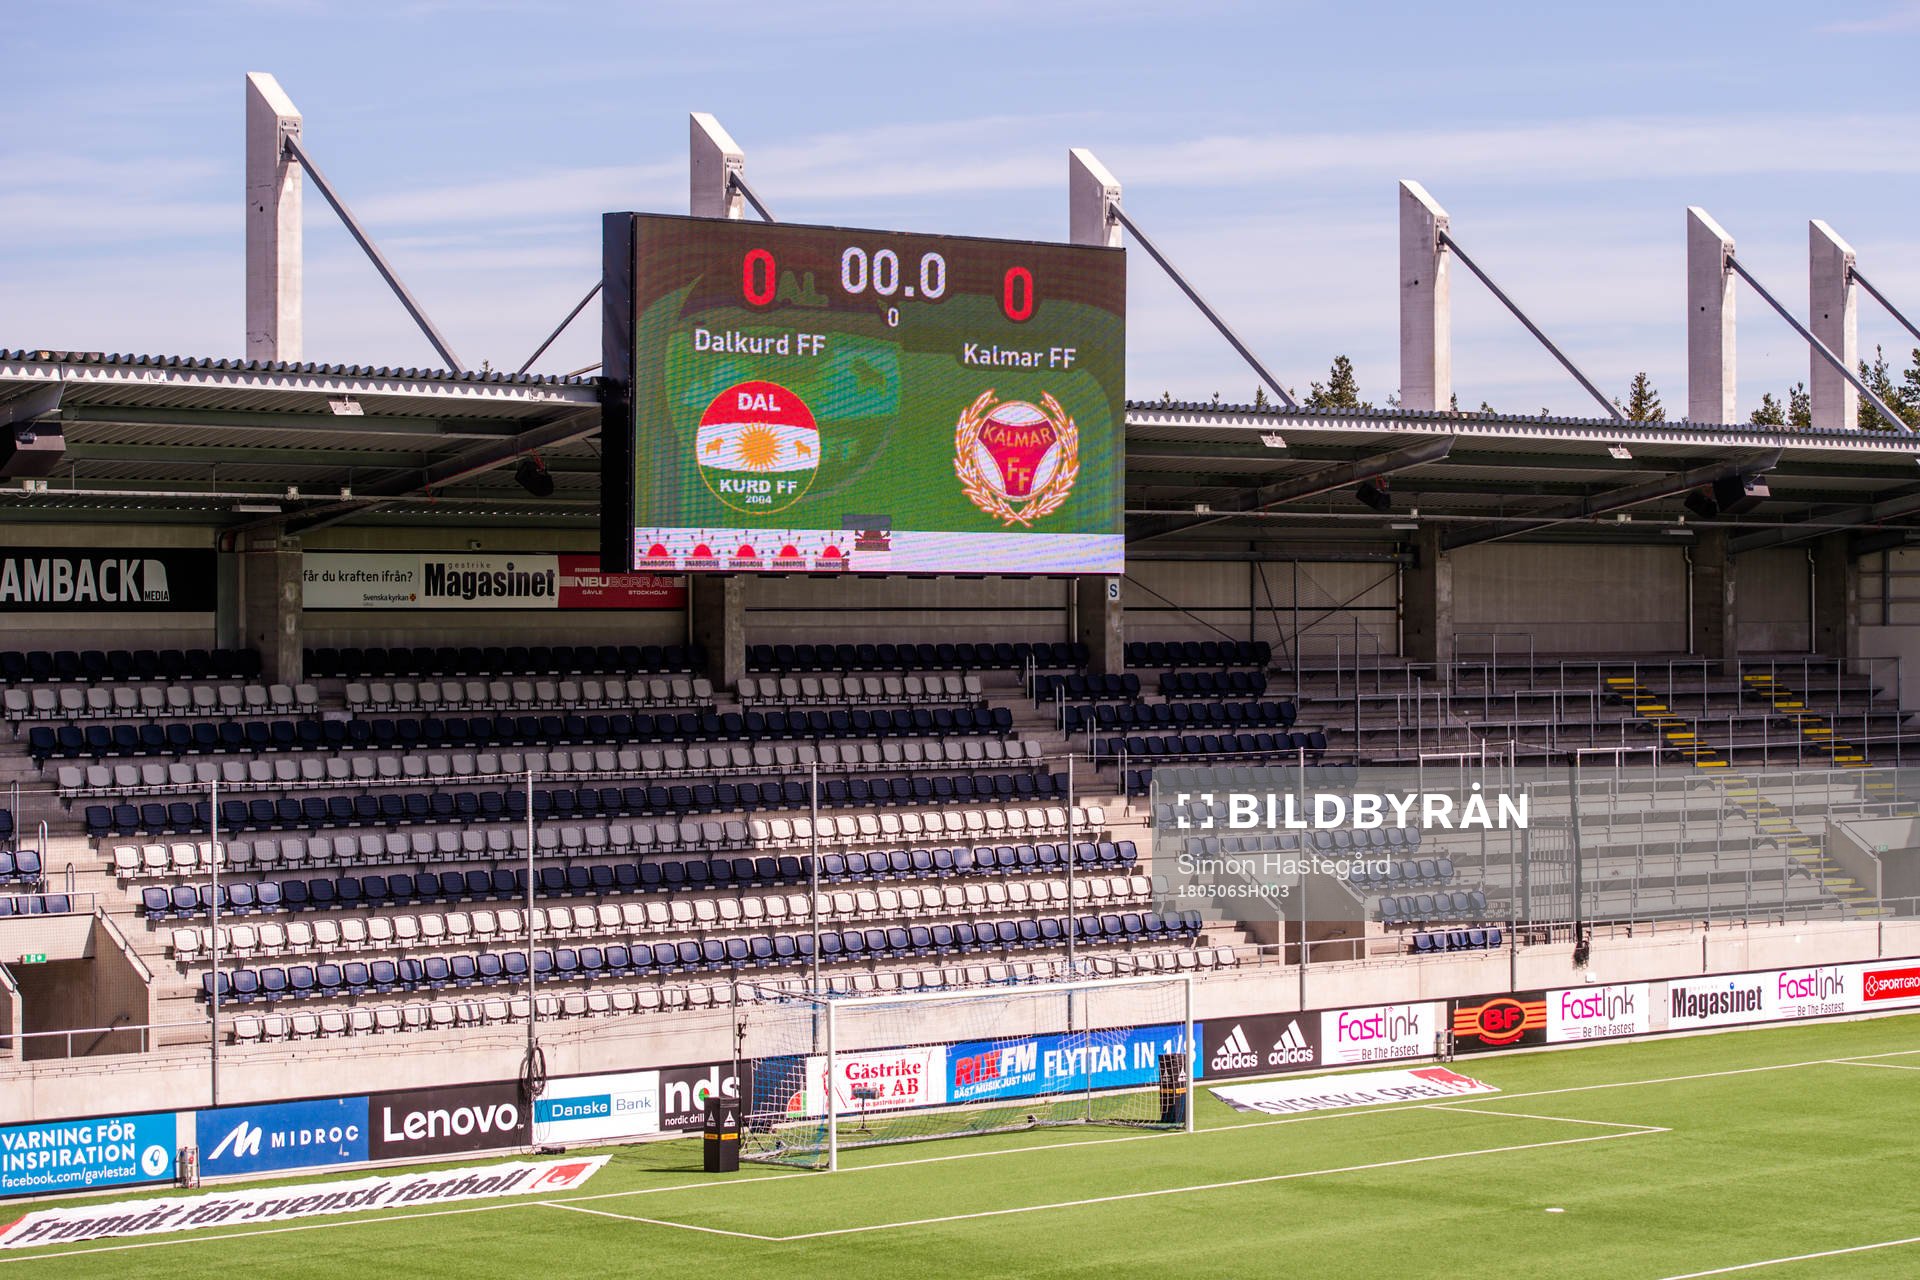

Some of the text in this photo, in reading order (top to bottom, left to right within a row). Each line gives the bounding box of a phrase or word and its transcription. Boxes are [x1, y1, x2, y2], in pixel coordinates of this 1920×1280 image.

[743, 249, 776, 305] 0
[841, 246, 946, 299] 00.0
[1004, 266, 1033, 321] 0
[887, 307, 899, 327] 0
[695, 328, 826, 356] Dalkurd FF
[963, 343, 1076, 368] Kalmar FF
[738, 392, 781, 412] DAL
[983, 423, 1052, 449] KALMAR
[720, 479, 798, 494] KURD FF
[0, 558, 142, 602] AMBACK
[303, 570, 413, 582] får du kraften ifrån?
[424, 562, 556, 601] Magasinet
[144, 590, 170, 601] MEDIA
[362, 593, 409, 604] Svenska kyrkan
[1109, 583, 1118, 598] S
[1672, 982, 1763, 1020] Magasinet
[1797, 1001, 1845, 1016] Be The Fastest
[1483, 1007, 1521, 1031] BF
[1583, 1021, 1635, 1038] Be The Fastest
[1043, 1044, 1127, 1079] FLYTTAR
[1133, 1040, 1156, 1069] IN
[1211, 1051, 1257, 1071] adidas
[1268, 1045, 1313, 1066] adidas
[1361, 1043, 1419, 1061] Be The Fastest
[845, 1058, 921, 1081] Gästrike
[890, 1078, 919, 1098] AB
[953, 1085, 976, 1100] BÄST
[1001, 1076, 1022, 1089] JUST
[1253, 1084, 1452, 1113] SVENSKA SPEL
[552, 1096, 652, 1117] Danske Bank
[383, 1103, 519, 1143] Lenovo
[665, 1113, 689, 1126] nordic
[1, 1119, 136, 1151] VARNING FÖR
[271, 1125, 359, 1148] MIDROC
[2, 1142, 136, 1172] INSPIRATION
[1, 1162, 136, 1188] facebook.com/gavlestad
[4, 1167, 537, 1245] Framåt för svensk fotboll
